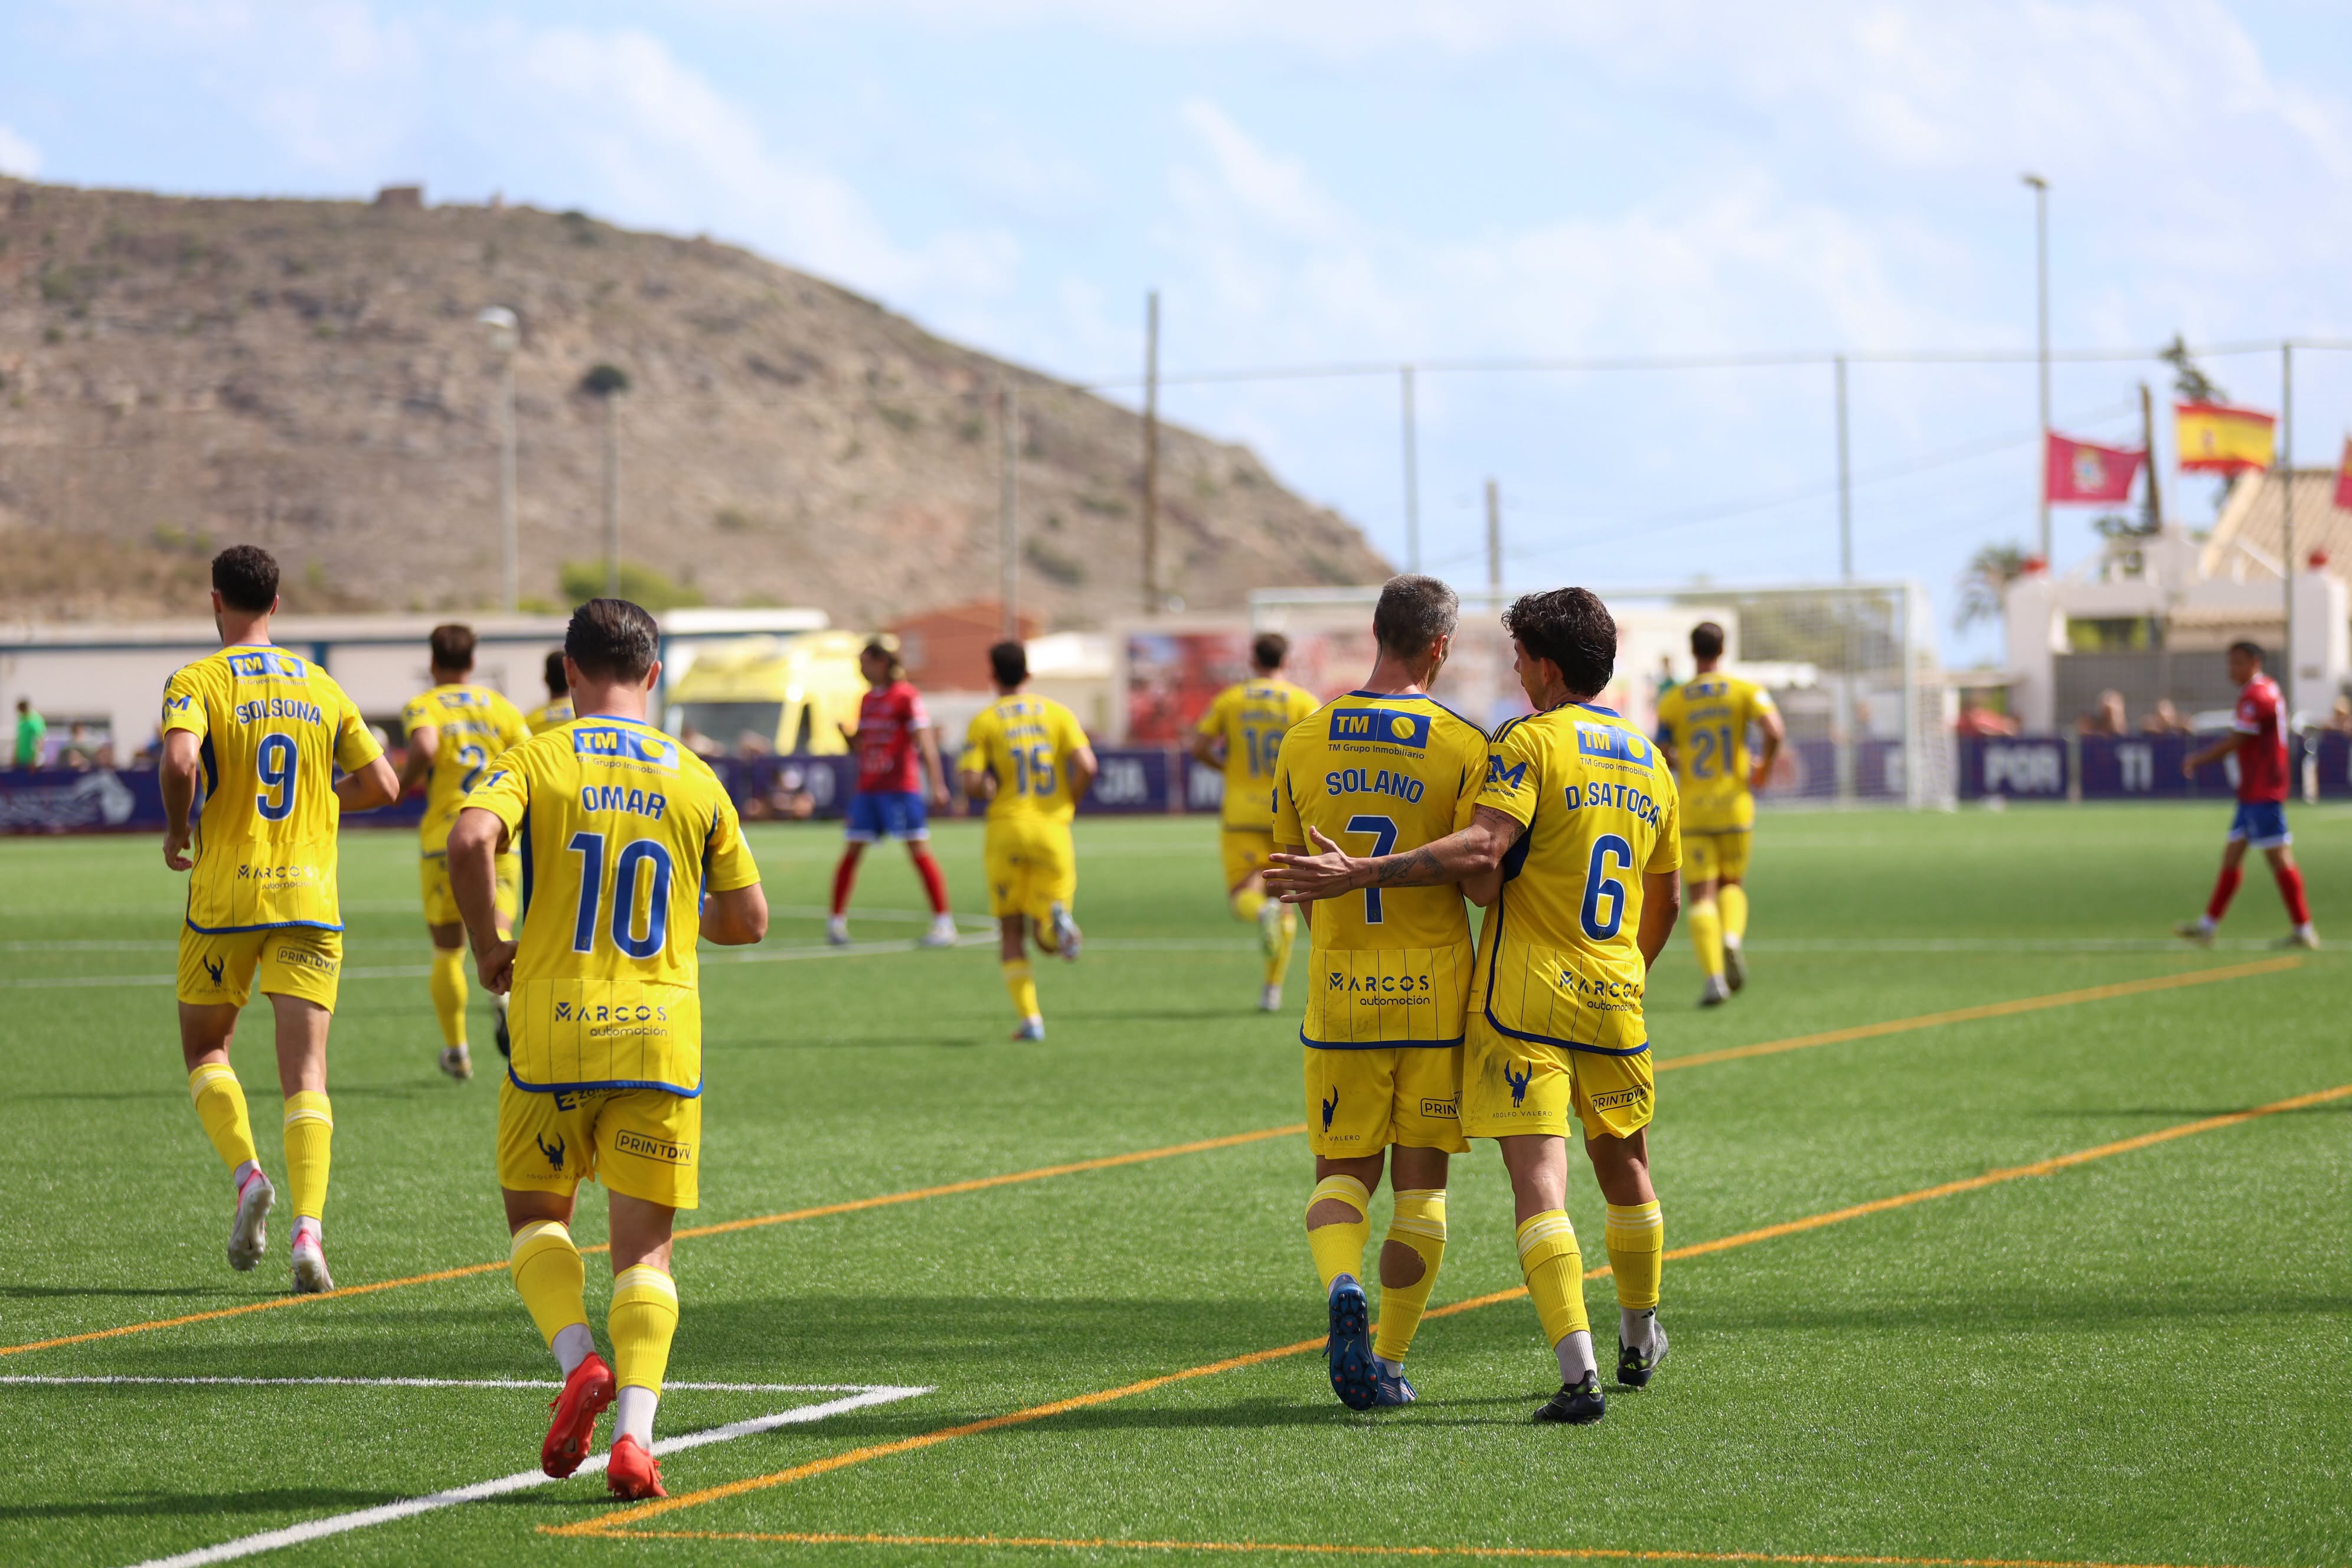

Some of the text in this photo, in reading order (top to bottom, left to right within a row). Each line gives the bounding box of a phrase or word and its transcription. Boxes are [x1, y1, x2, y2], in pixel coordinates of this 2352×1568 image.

[233, 656, 263, 672] TM
[236, 698, 321, 727] SOLSONA
[1337, 716, 1369, 733] TM
[579, 732, 618, 749] TM
[1344, 744, 1370, 754] Grupo
[1373, 746, 1425, 759] Inmobiliario
[1582, 730, 1611, 751] TM
[1691, 728, 1732, 779] 21
[256, 732, 298, 822] 9
[593, 758, 621, 769] Grupo
[624, 762, 680, 780] Inmobiliario
[1010, 746, 1057, 796] 15
[1594, 760, 1614, 770] Grupo
[1616, 763, 1655, 780] Inmobiliario
[1325, 768, 1425, 804] SOLANO
[582, 786, 667, 821] OMAR
[1564, 782, 1660, 829] D.SATOCA
[1344, 815, 1398, 925] 7
[567, 831, 672, 959] 10
[1579, 833, 1632, 940] 6
[1329, 973, 1429, 991] MARCOS
[1360, 995, 1430, 1005] automoción
[555, 1002, 667, 1021] MARCOS
[590, 1025, 667, 1037] automoción
